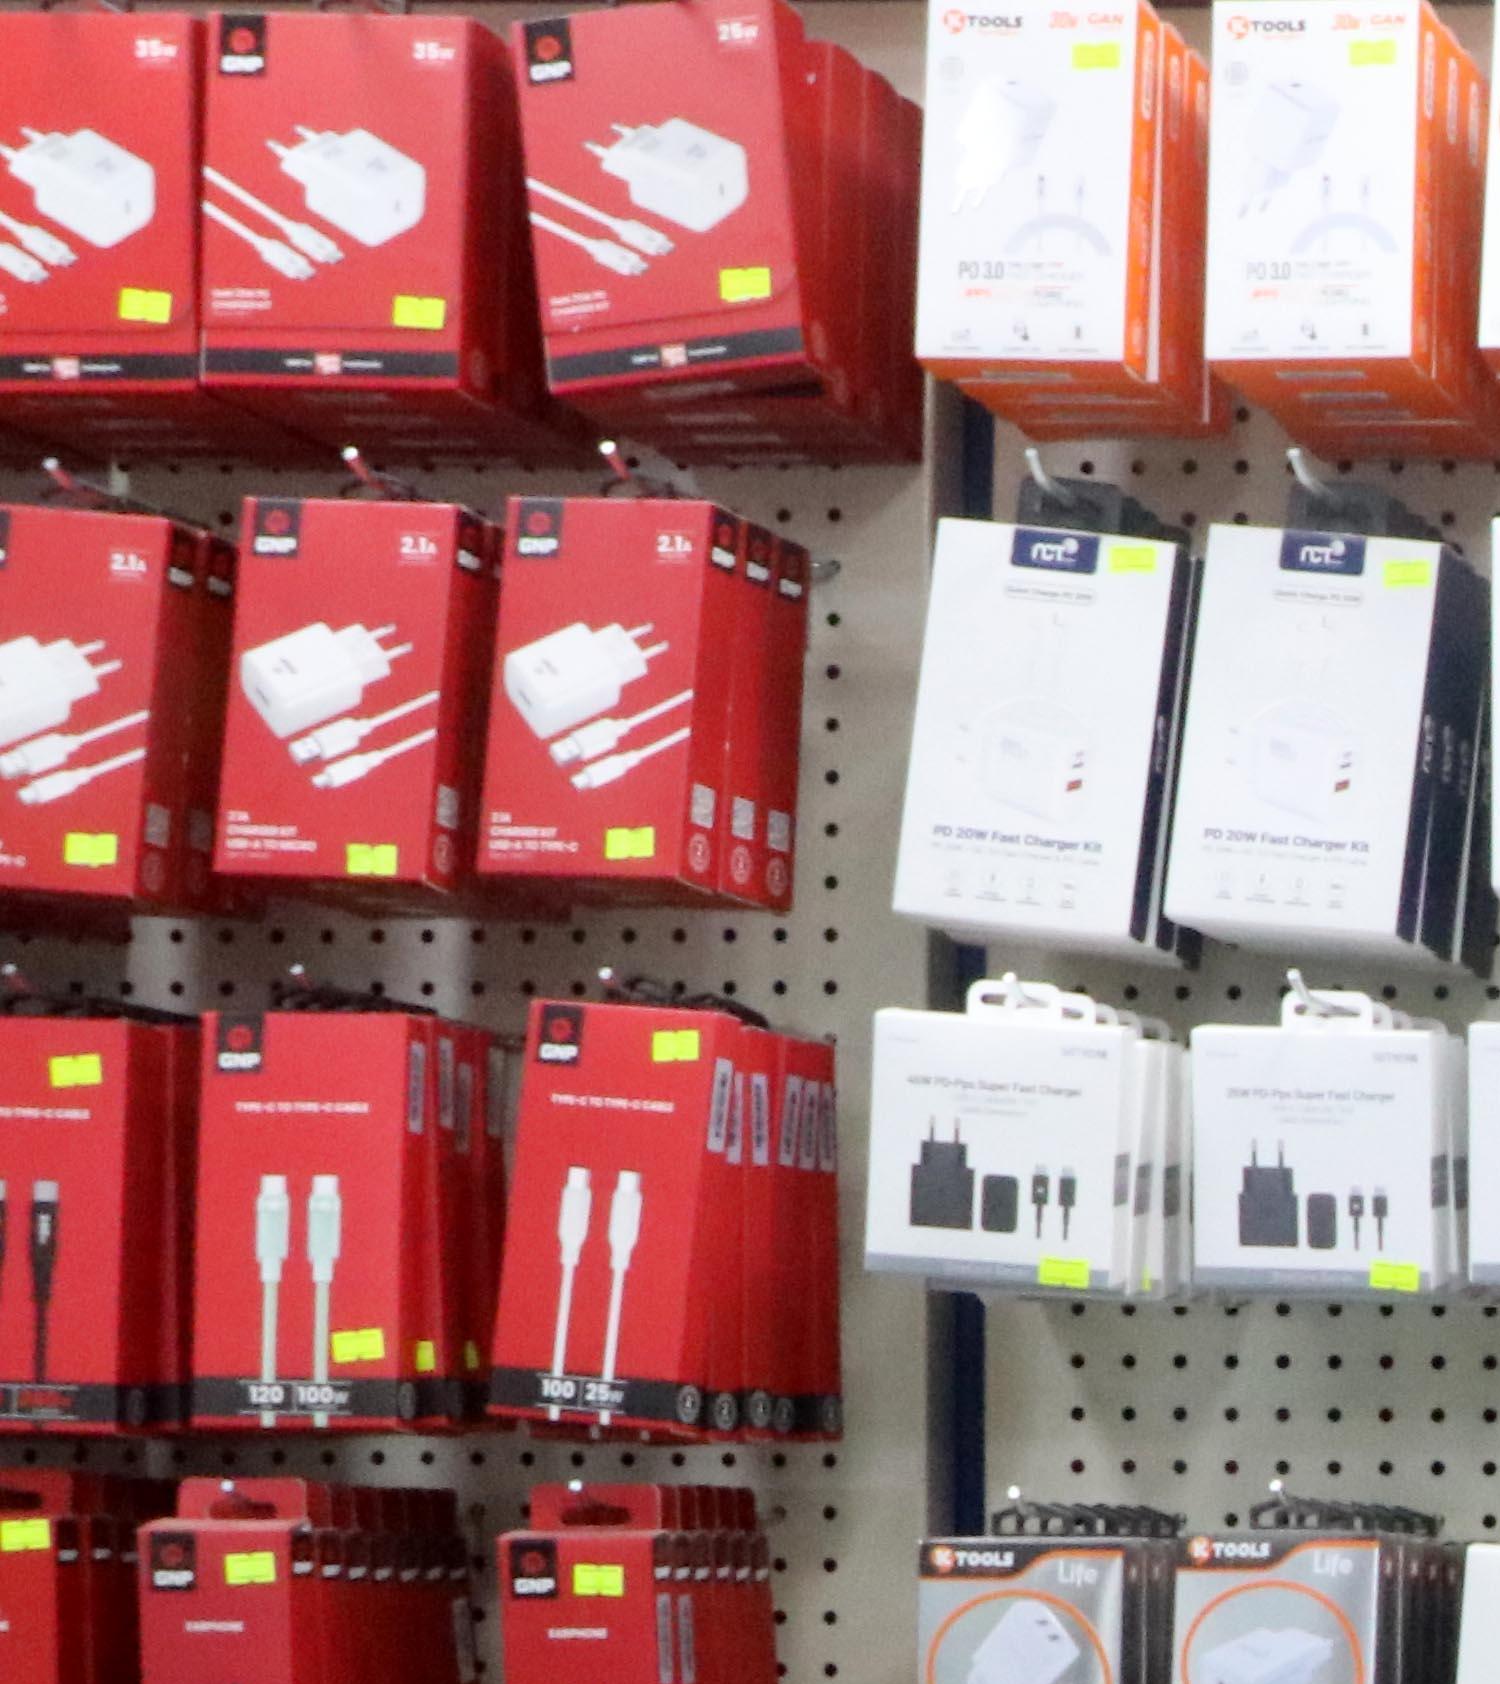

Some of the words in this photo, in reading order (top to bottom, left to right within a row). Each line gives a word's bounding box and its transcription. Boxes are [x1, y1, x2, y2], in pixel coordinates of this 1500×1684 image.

[248, 1384, 284, 1404] 120
[541, 1378, 575, 1399] 100
[1058, 1560, 1099, 1588] Life
[1313, 1550, 1353, 1578] Life
